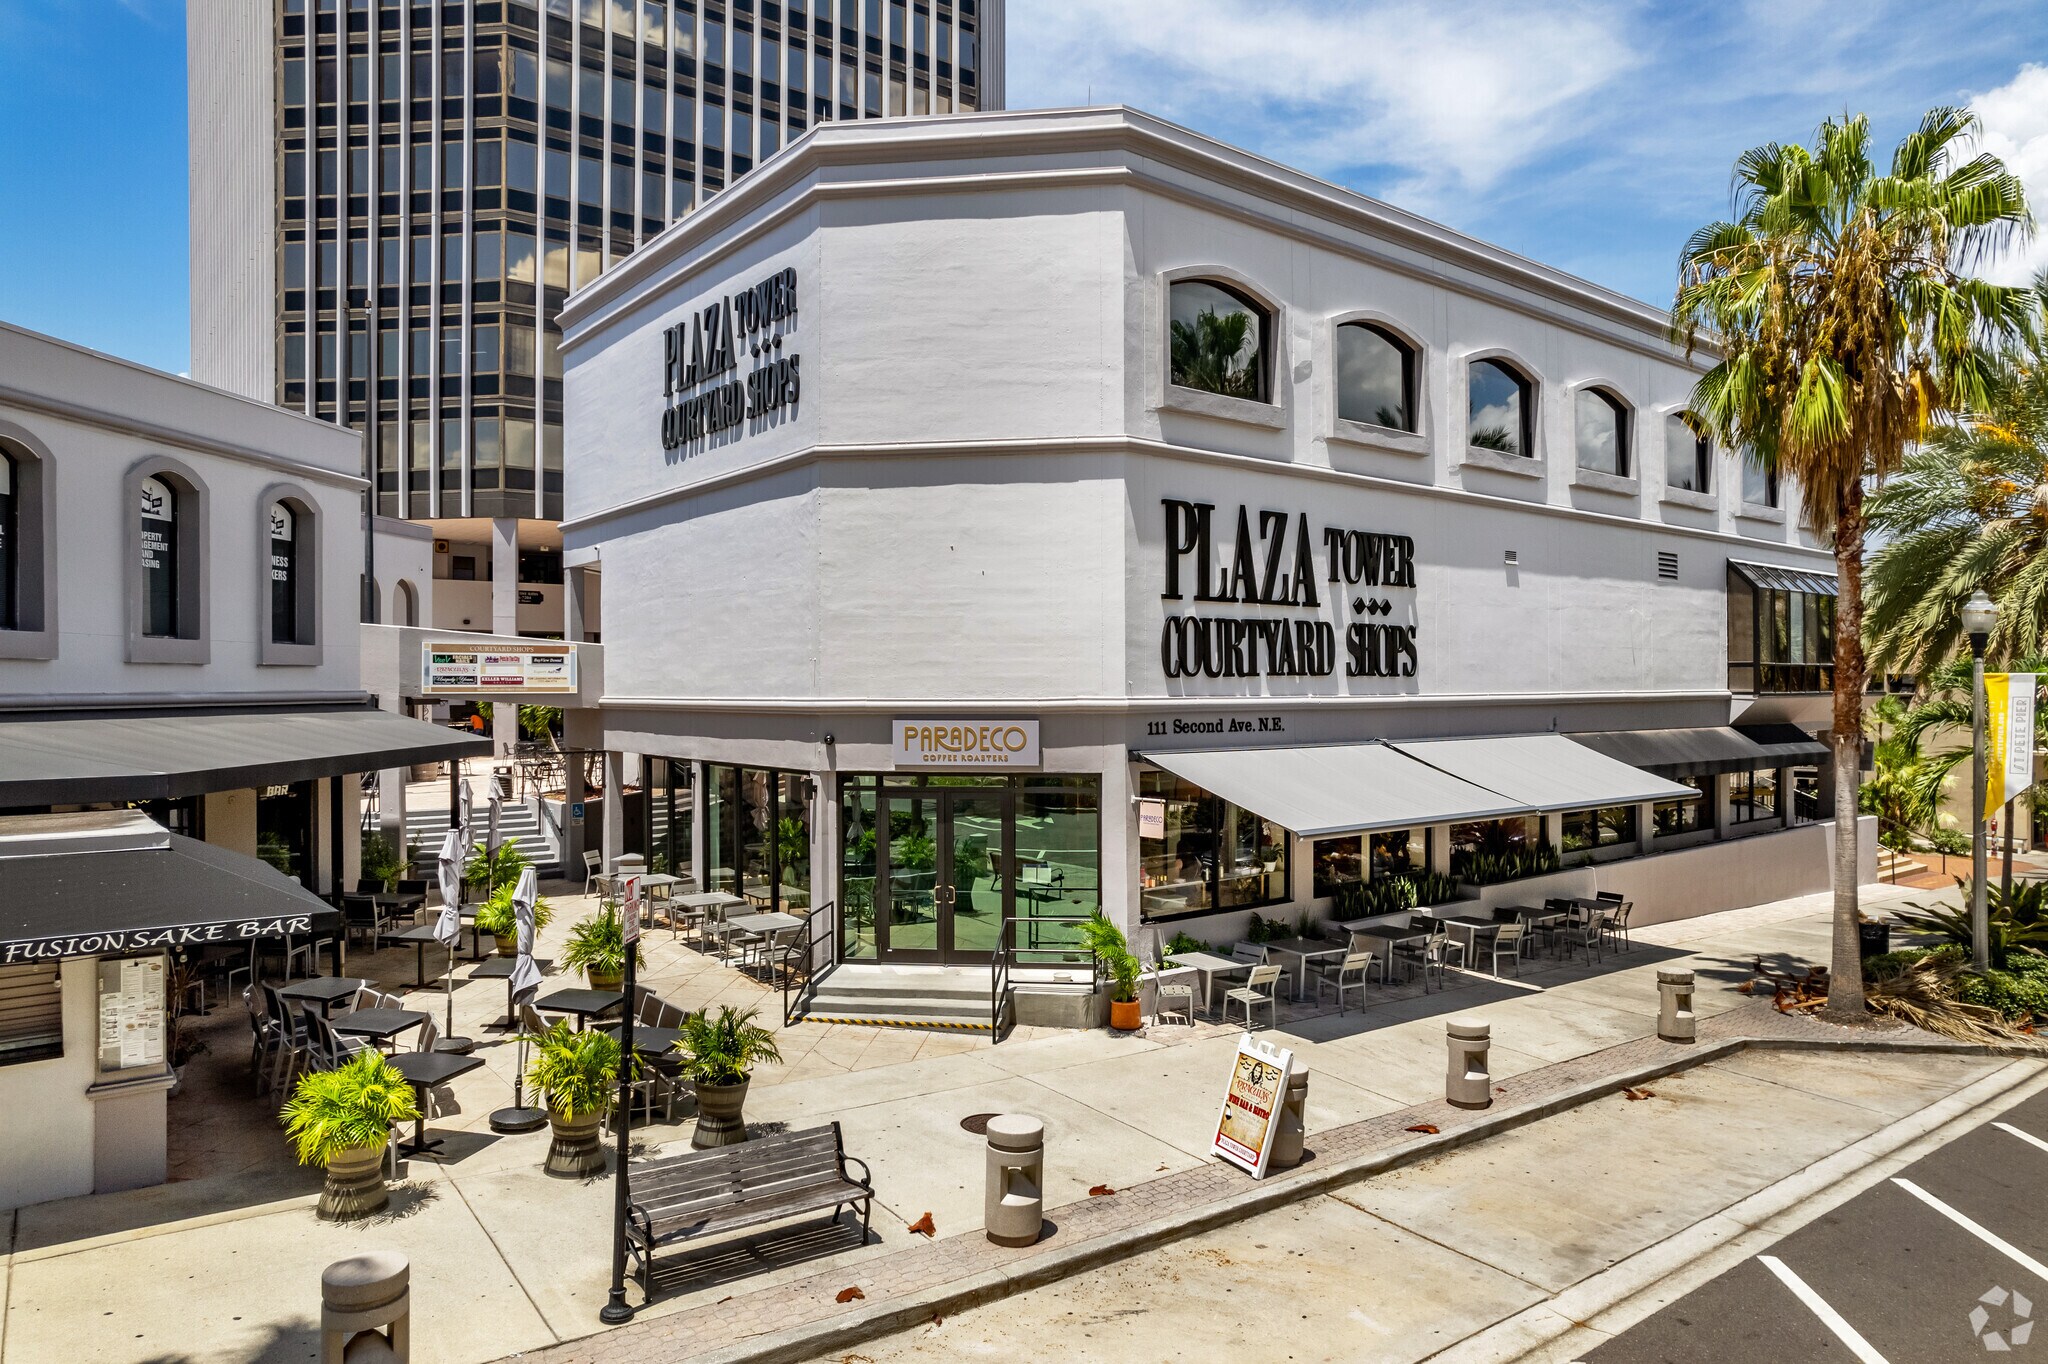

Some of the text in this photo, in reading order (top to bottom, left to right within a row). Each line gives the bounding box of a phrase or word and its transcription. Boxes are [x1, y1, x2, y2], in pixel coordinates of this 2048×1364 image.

[663, 266, 798, 398] PLAZA TOWER
[661, 354, 800, 450] COURTYARD SHOPS
[1161, 499, 1416, 608] PLAZA TOWER
[470, 645, 511, 653] COURTYARD
[1161, 615, 1417, 678] COURTYARD SHOPS
[904, 726, 1027, 752] PARADECO
[1147, 717, 1285, 735] 111 Second Ave. N.E.
[2013, 699, 2027, 772] ST PETE PIER
[922, 754, 1009, 763] COFFEE ROASTERS
[266, 784, 289, 797] BAR
[5, 916, 312, 963] FUSION SAKE BAR
